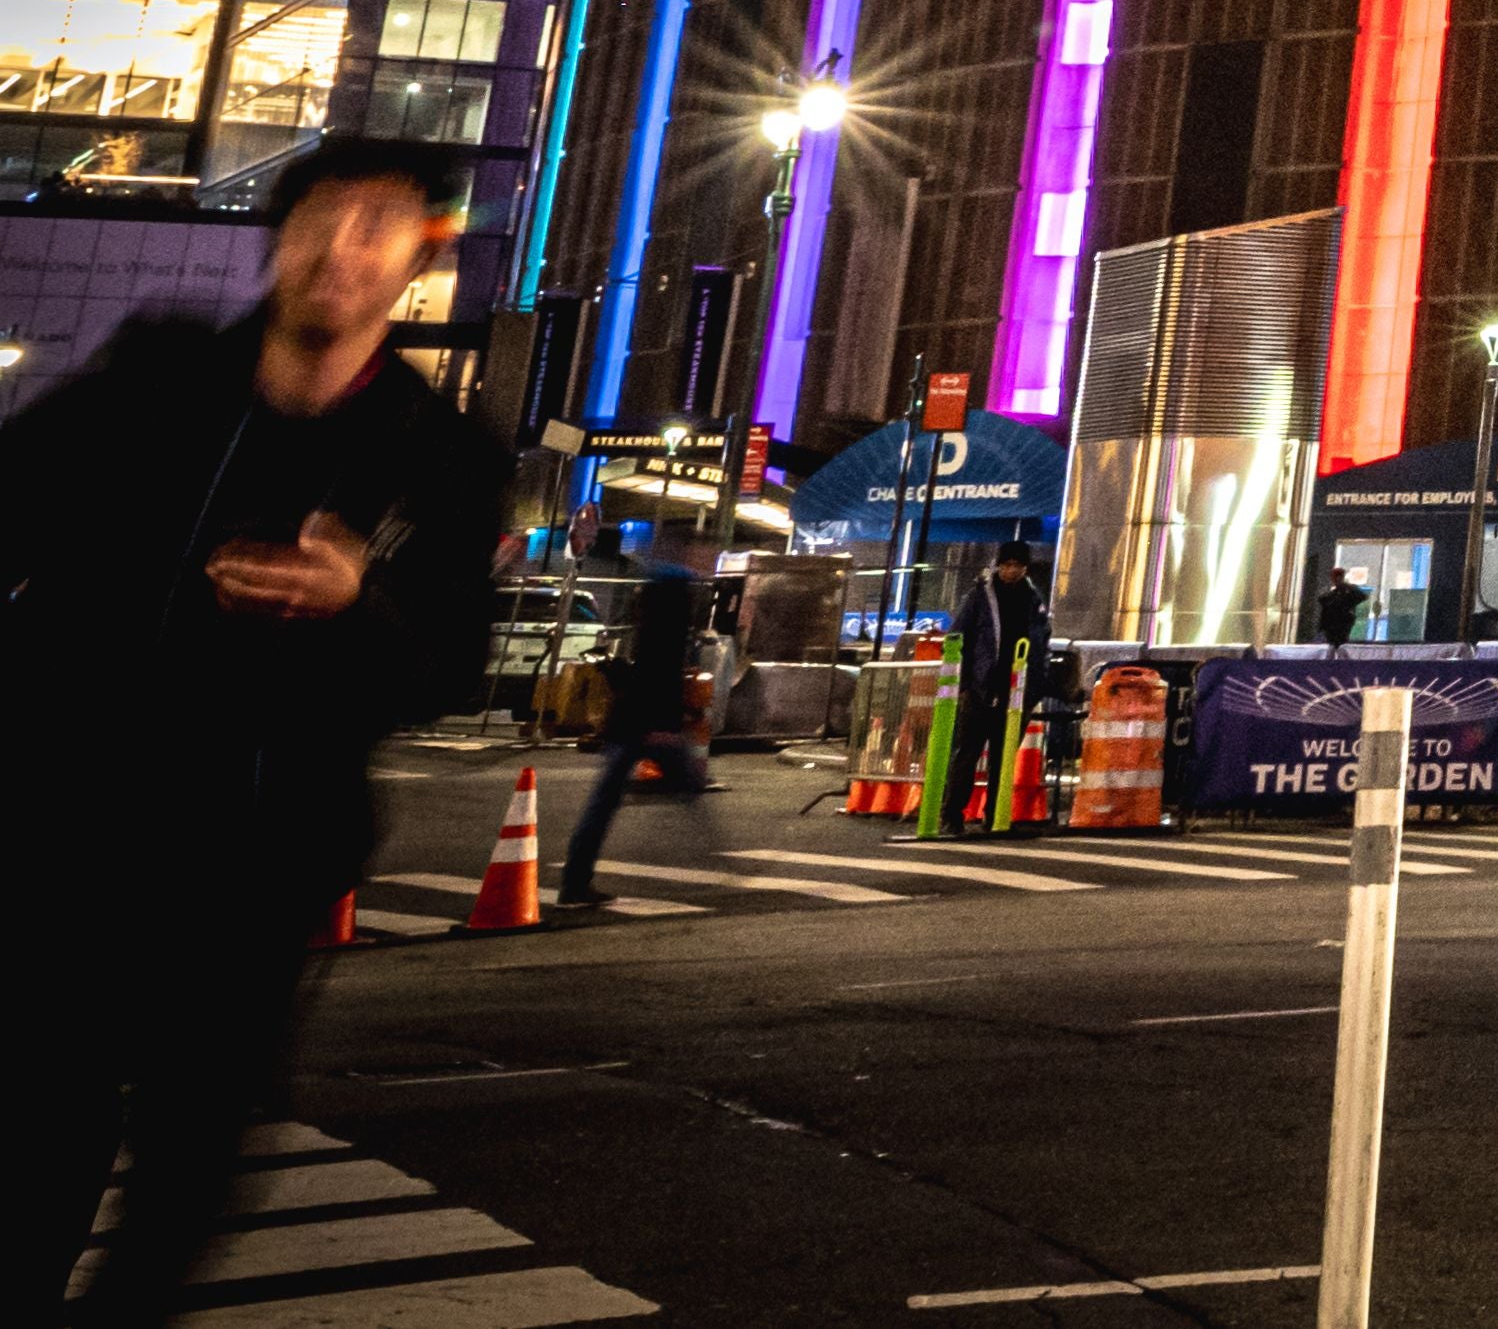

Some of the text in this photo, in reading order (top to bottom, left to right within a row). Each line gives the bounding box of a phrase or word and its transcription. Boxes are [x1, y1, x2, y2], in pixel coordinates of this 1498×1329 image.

[646, 458, 683, 476] NIK
[868, 484, 1021, 502] CHAE ENTRANCE
[1326, 493, 1391, 506] ENTRANCE
[1394, 493, 1418, 505] FOR
[1303, 739, 1452, 758] WELCE TO
[1250, 763, 1495, 794] THE GRDEN
